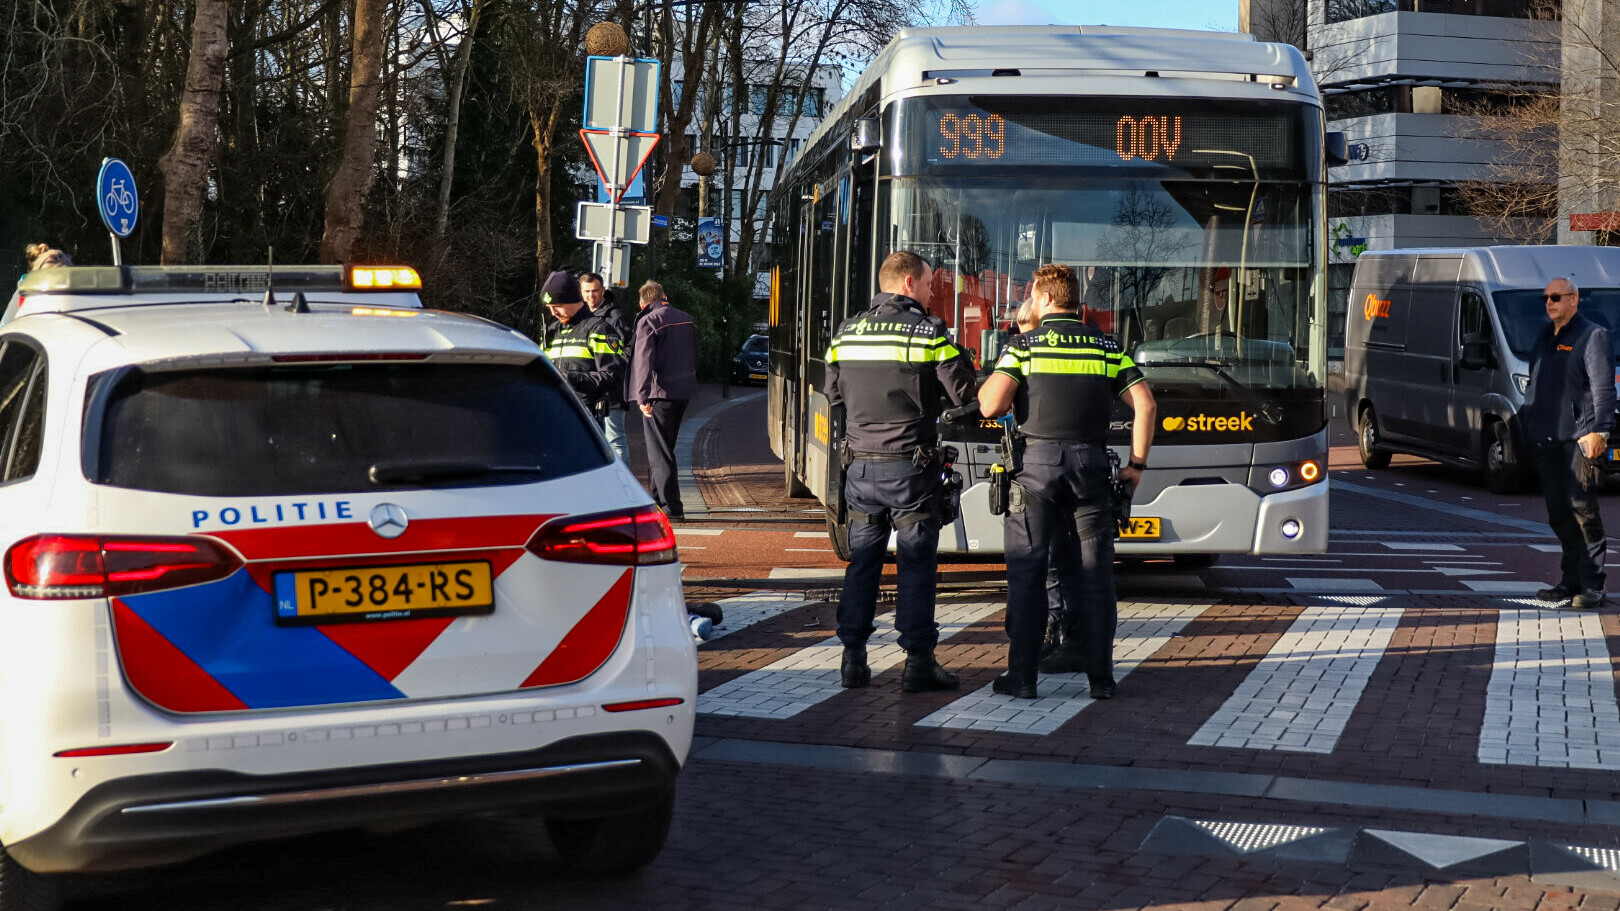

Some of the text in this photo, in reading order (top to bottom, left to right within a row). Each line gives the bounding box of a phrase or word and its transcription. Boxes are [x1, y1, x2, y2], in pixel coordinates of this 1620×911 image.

[940, 113, 1004, 159] 999
[1187, 411, 1254, 431] streek
[192, 501, 353, 528] POLITIE
[309, 569, 475, 610] P-384-RS
[279, 600, 295, 610] NL
